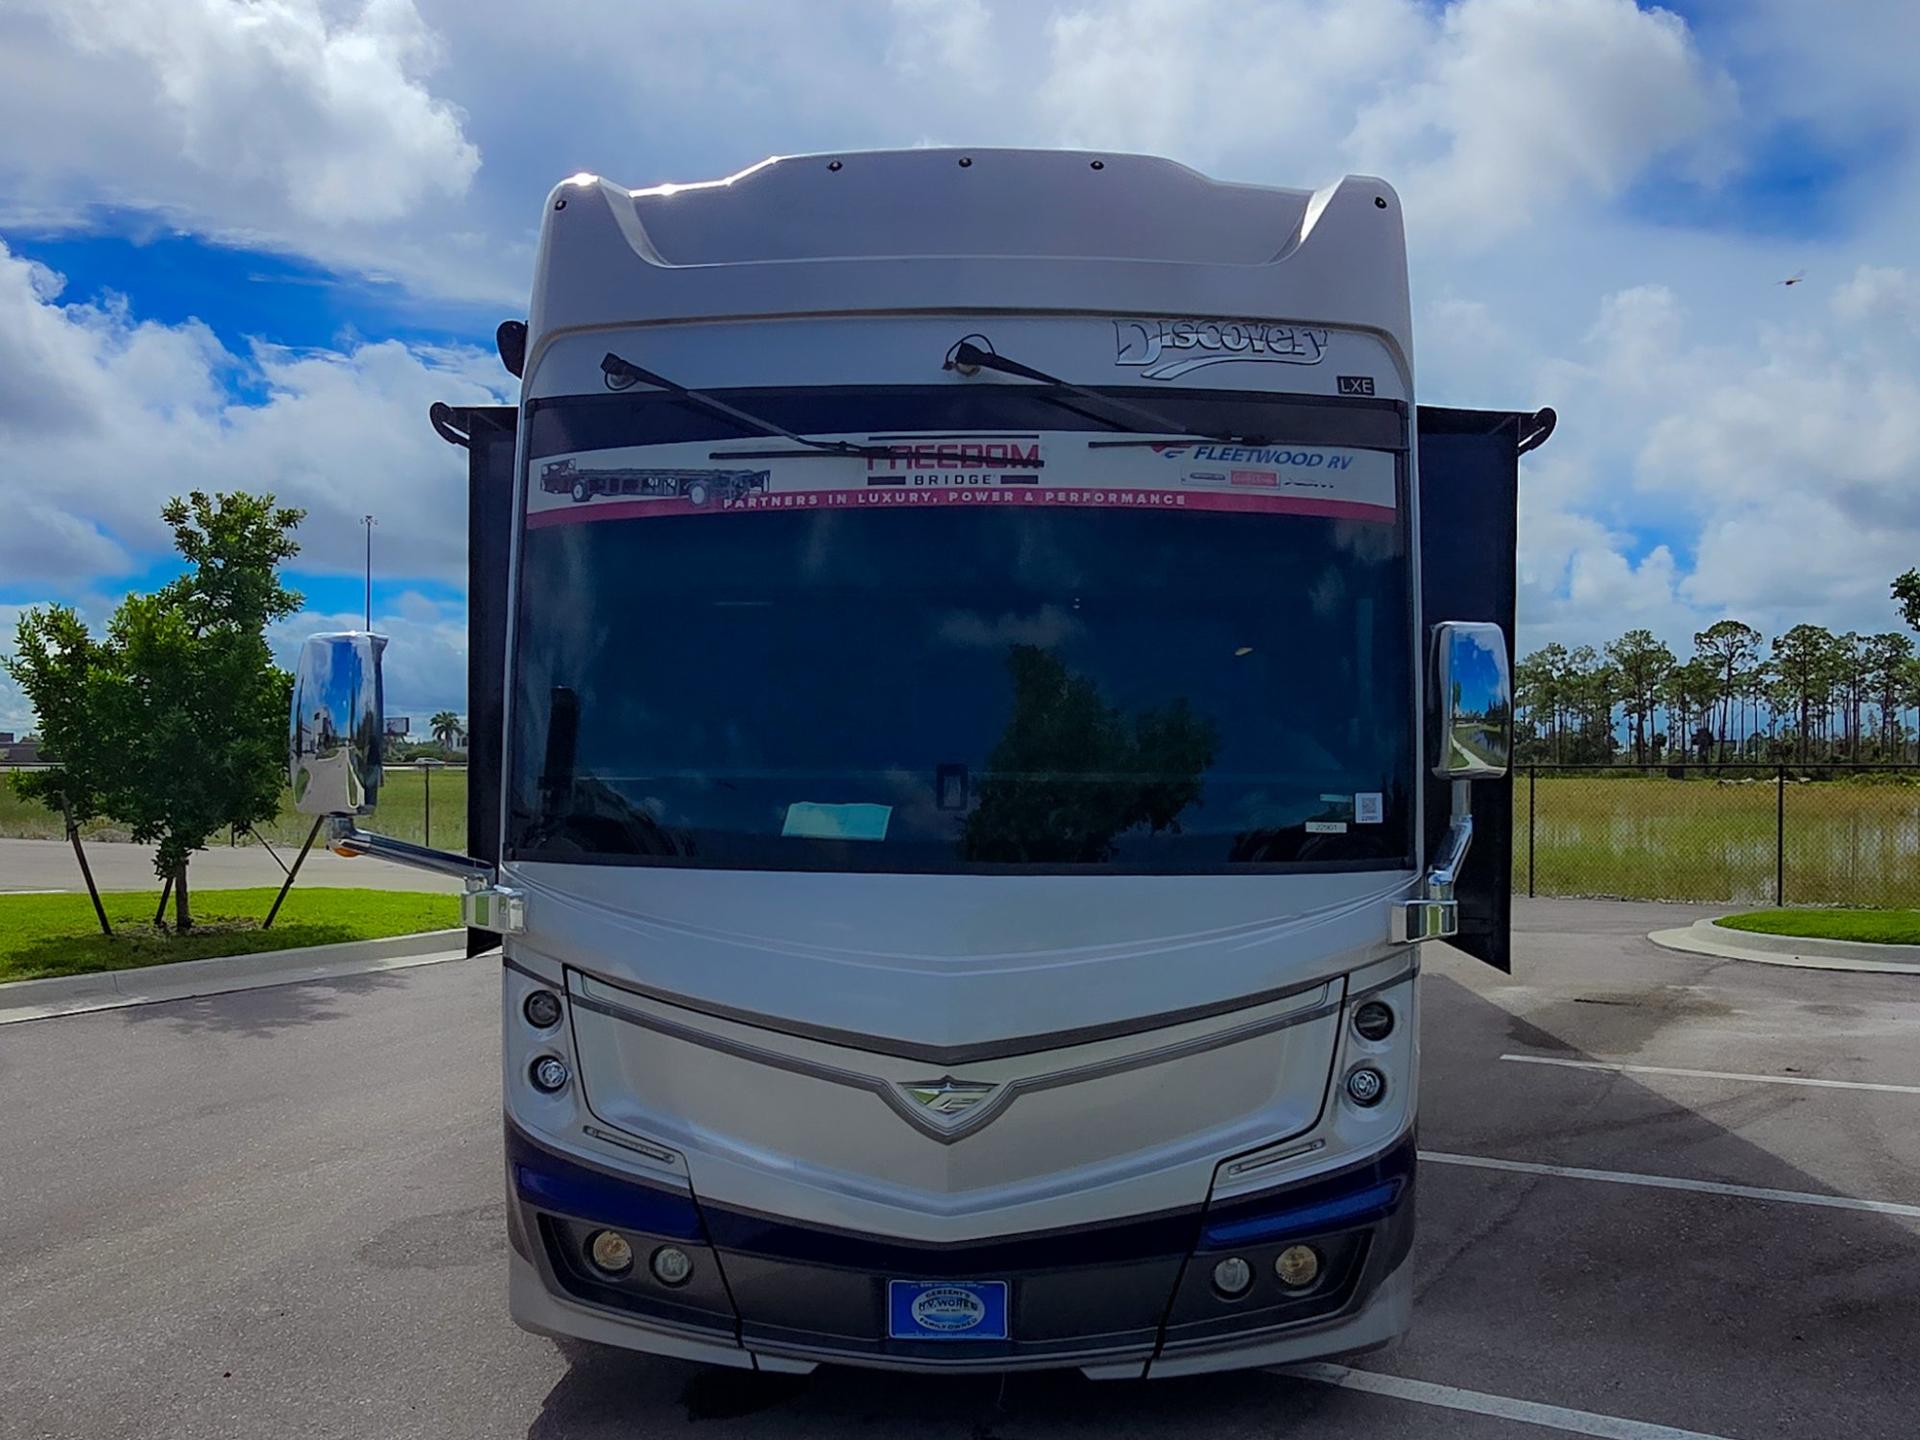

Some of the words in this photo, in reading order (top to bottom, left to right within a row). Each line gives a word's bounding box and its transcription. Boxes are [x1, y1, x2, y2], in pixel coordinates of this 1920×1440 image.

[1112, 319, 1328, 380] Discovery
[1340, 378, 1373, 394] LXE
[1193, 446, 1324, 467] FLEETWOOD
[1327, 455, 1354, 470] RV
[914, 474, 992, 486] BRIDGE
[722, 494, 819, 510] PARTNERS
[827, 494, 848, 505] IN
[857, 491, 938, 504] LUXURY,
[948, 491, 1014, 502] POWER
[1023, 491, 1034, 502] &
[1044, 491, 1186, 505] PERFORMANCE
